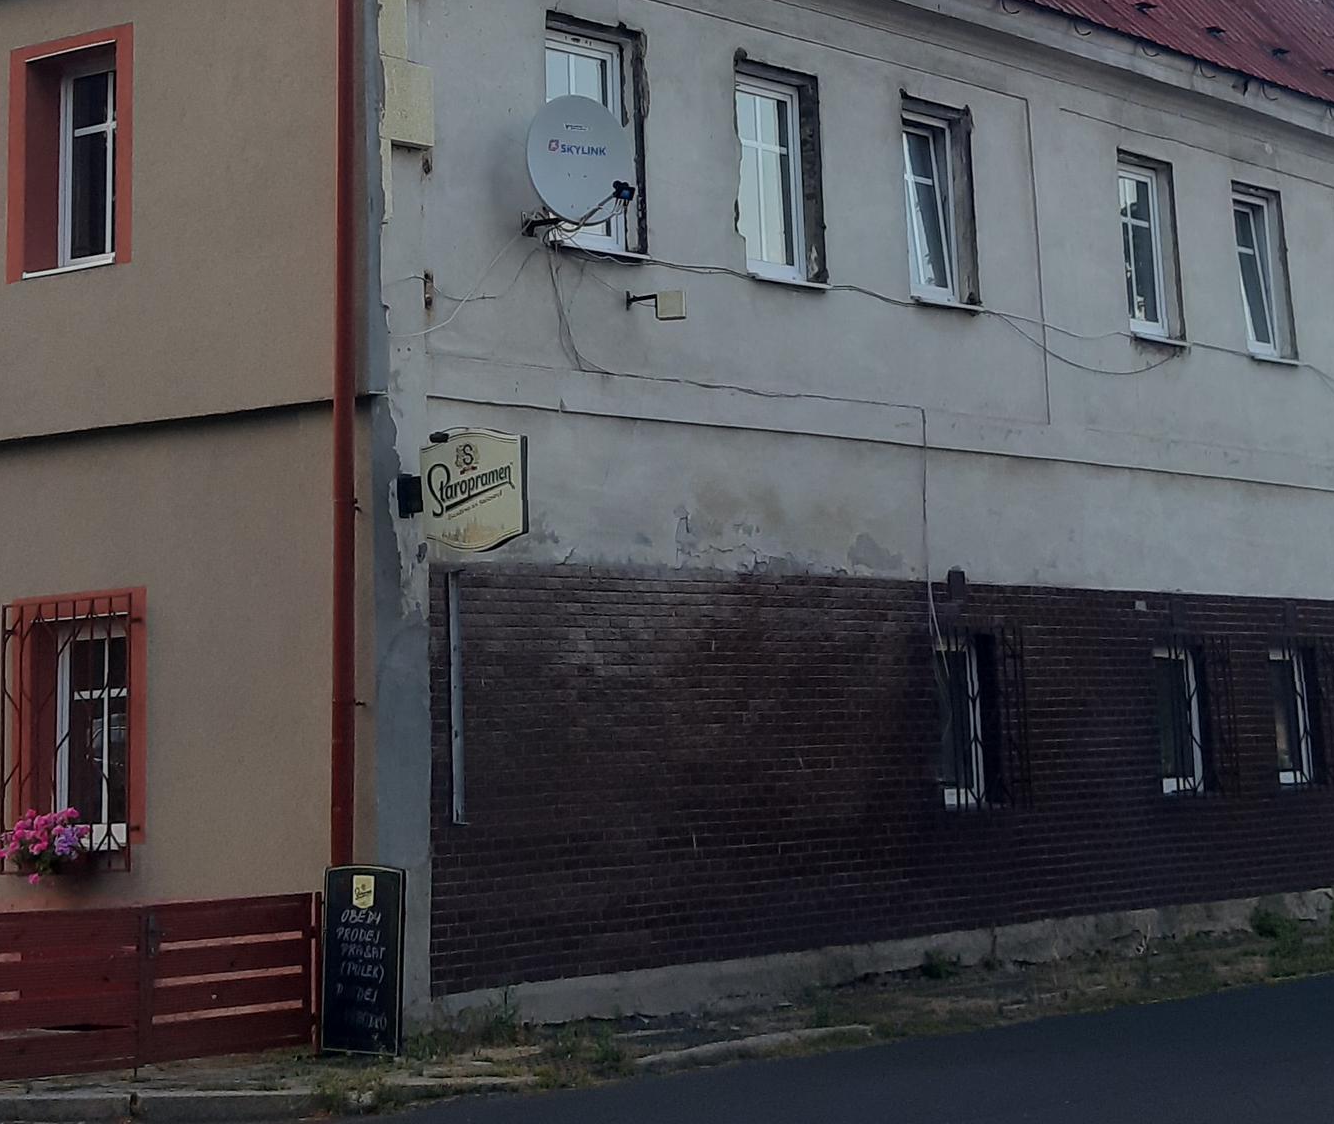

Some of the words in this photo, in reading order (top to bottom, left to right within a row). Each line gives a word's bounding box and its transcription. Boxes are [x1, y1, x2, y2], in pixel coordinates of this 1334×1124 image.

[561, 144, 606, 156] SKYLINK
[428, 463, 515, 517] Staropramen
[336, 926, 381, 944] PRODEJ
